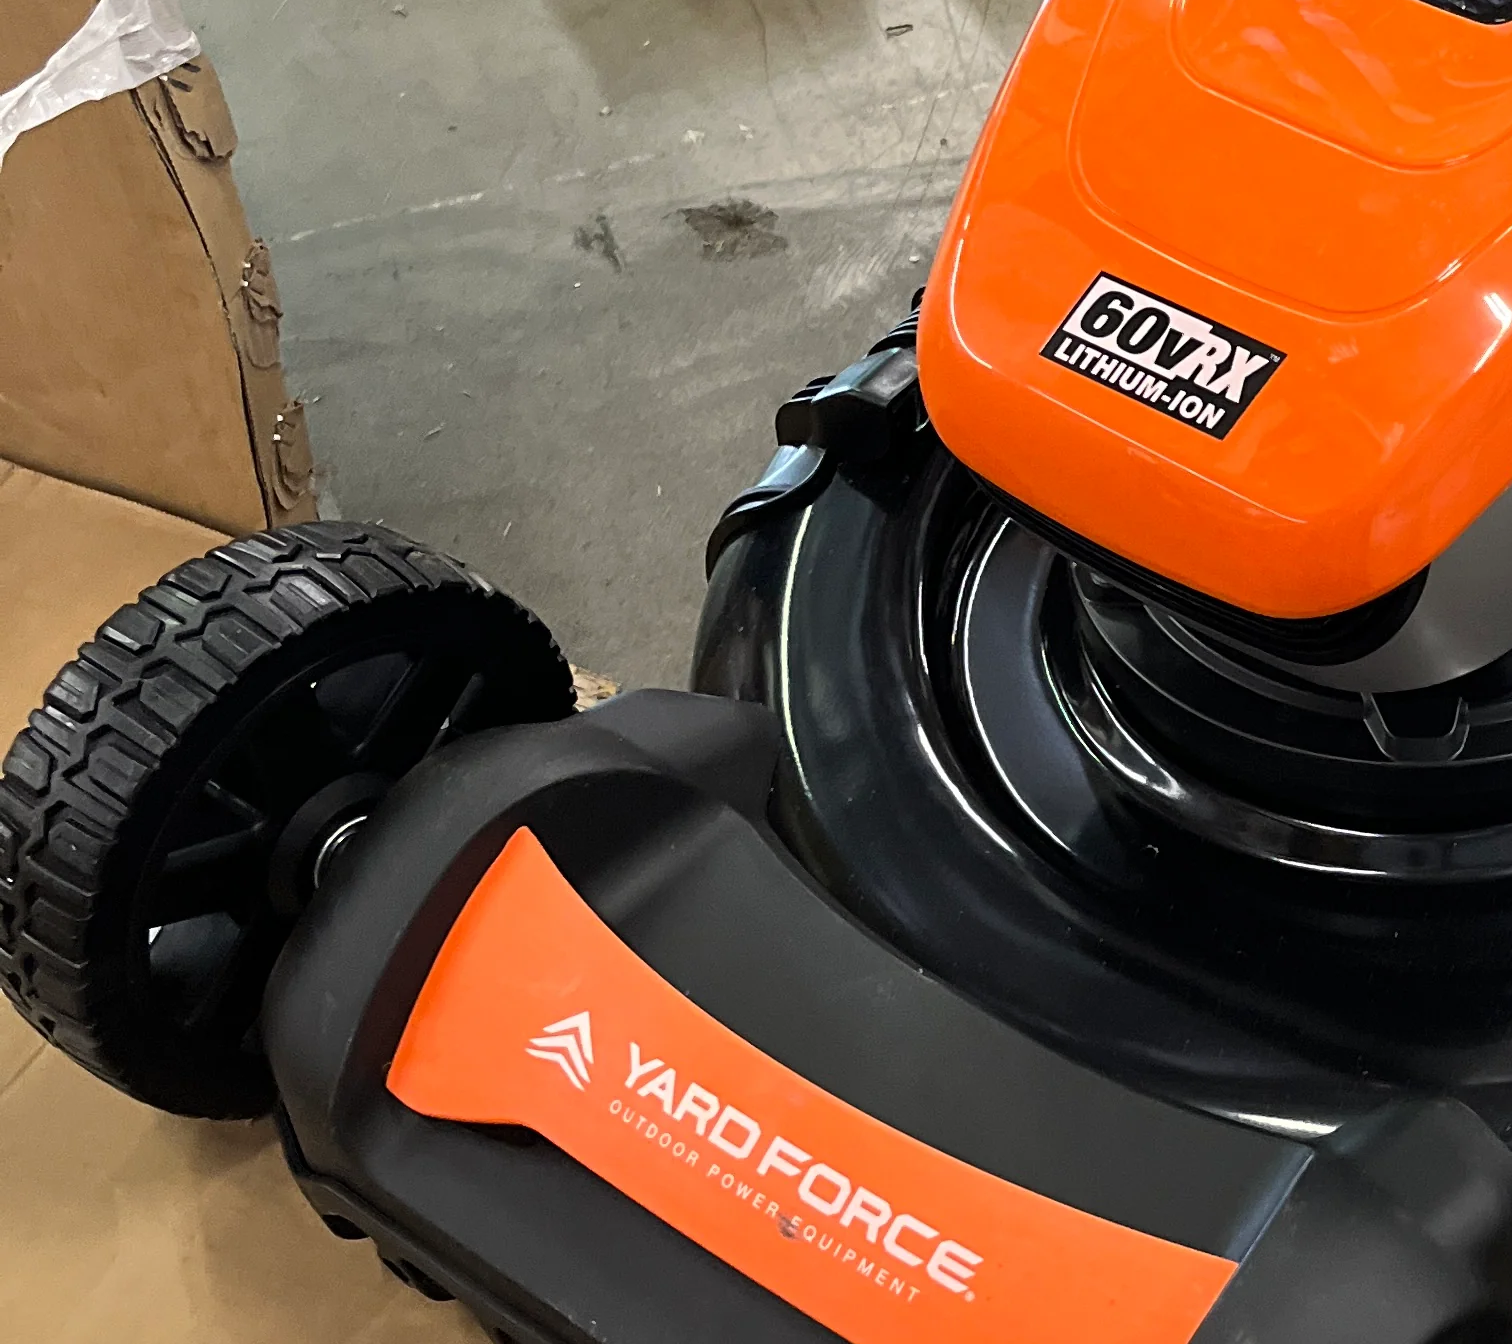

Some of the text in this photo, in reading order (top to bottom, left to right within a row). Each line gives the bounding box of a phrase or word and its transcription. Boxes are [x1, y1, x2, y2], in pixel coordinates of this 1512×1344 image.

[1053, 336, 1226, 430] LITHIUM-ION
[608, 1098, 921, 1304] OUTDOOR POWER EQUIPMENT
[624, 1041, 984, 1296] YARD FORCE
